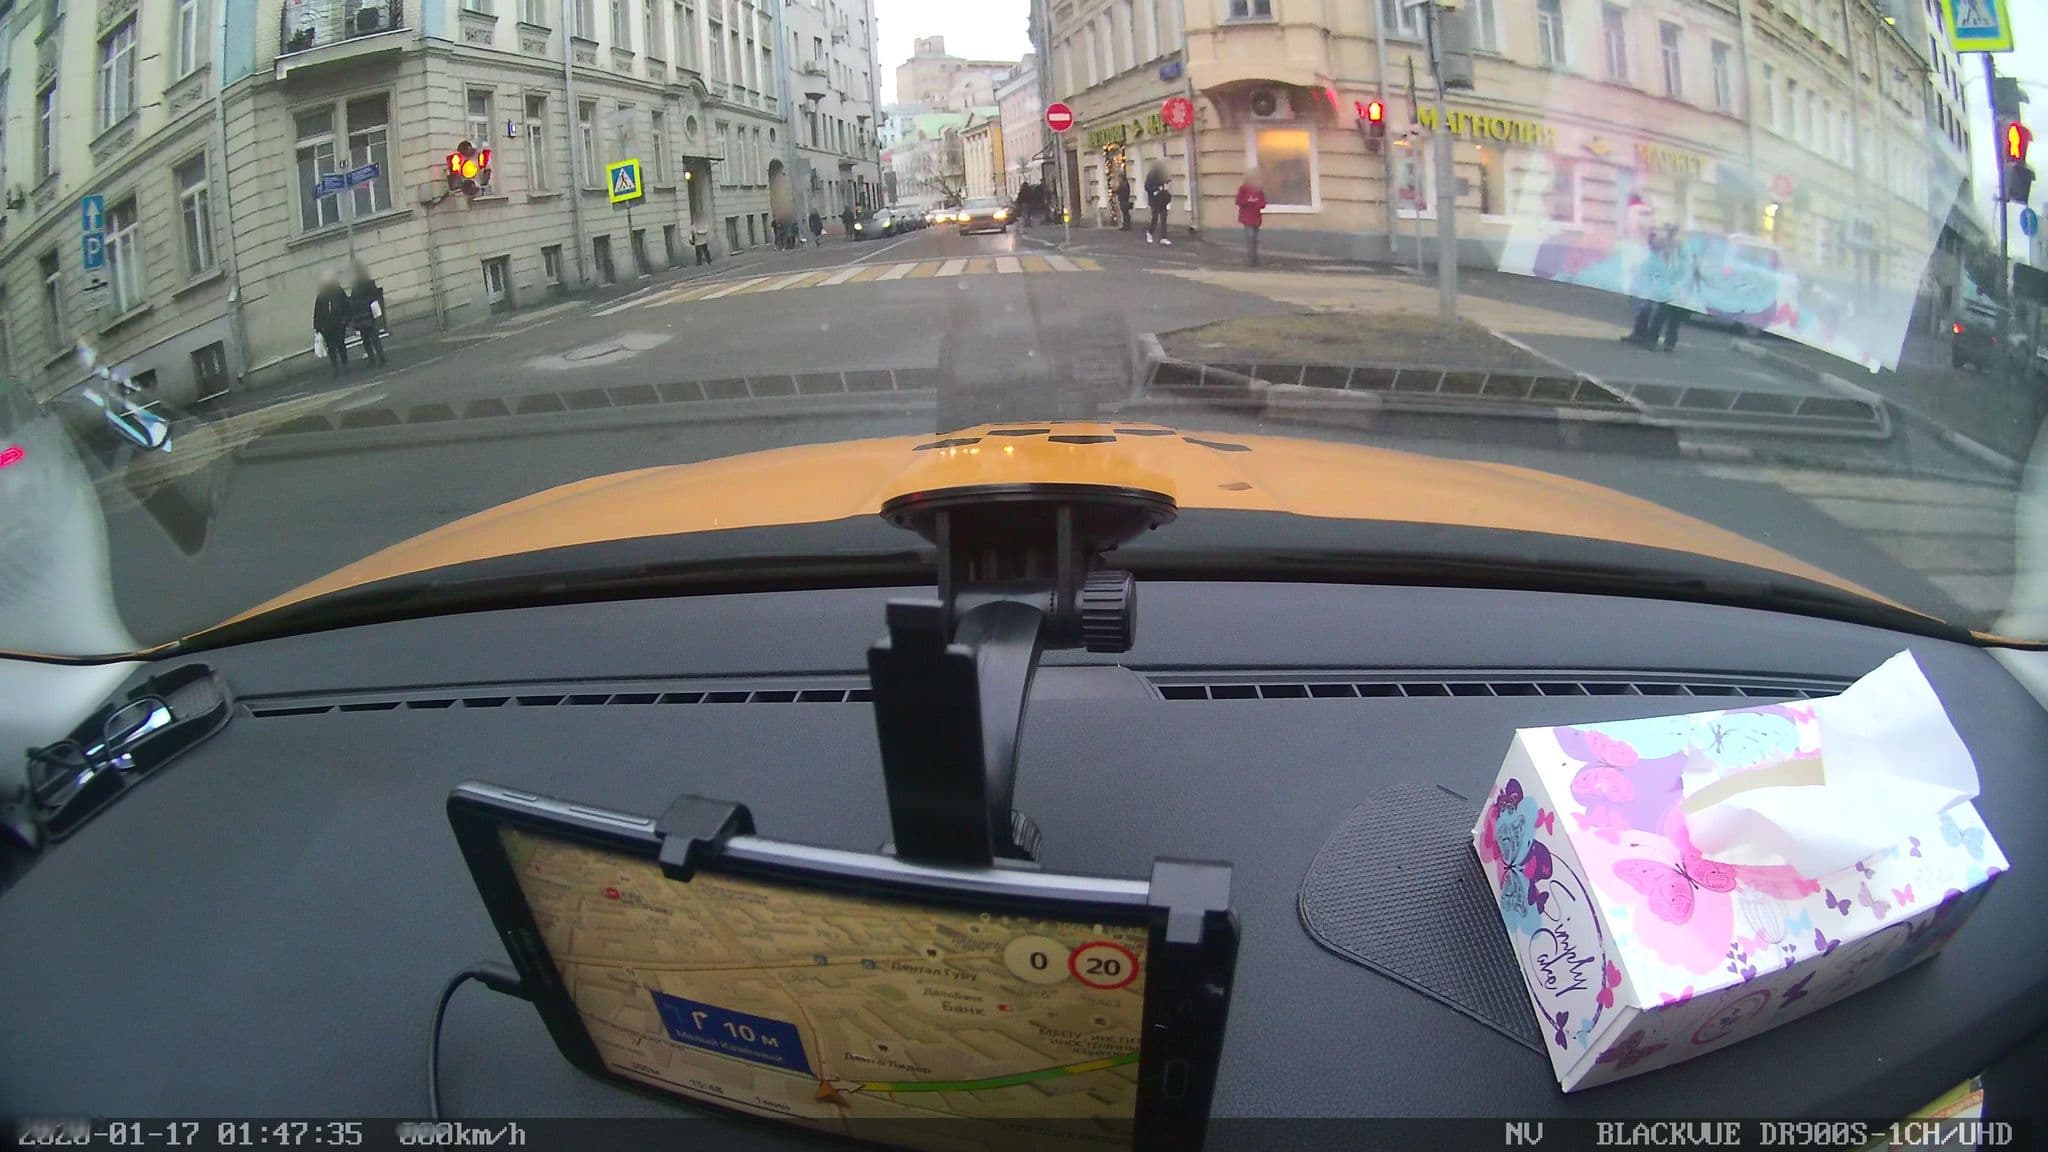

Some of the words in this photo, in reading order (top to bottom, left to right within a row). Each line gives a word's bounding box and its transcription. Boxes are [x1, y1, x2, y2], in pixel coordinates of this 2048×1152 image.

[1418, 106, 1556, 144] МАГНОЛИЯ
[1540, 879, 1595, 997] Simply
[1030, 952, 1048, 970] 0
[1086, 957, 1121, 976] 20
[1529, 928, 1558, 990] Care
[724, 1021, 756, 1043] 10
